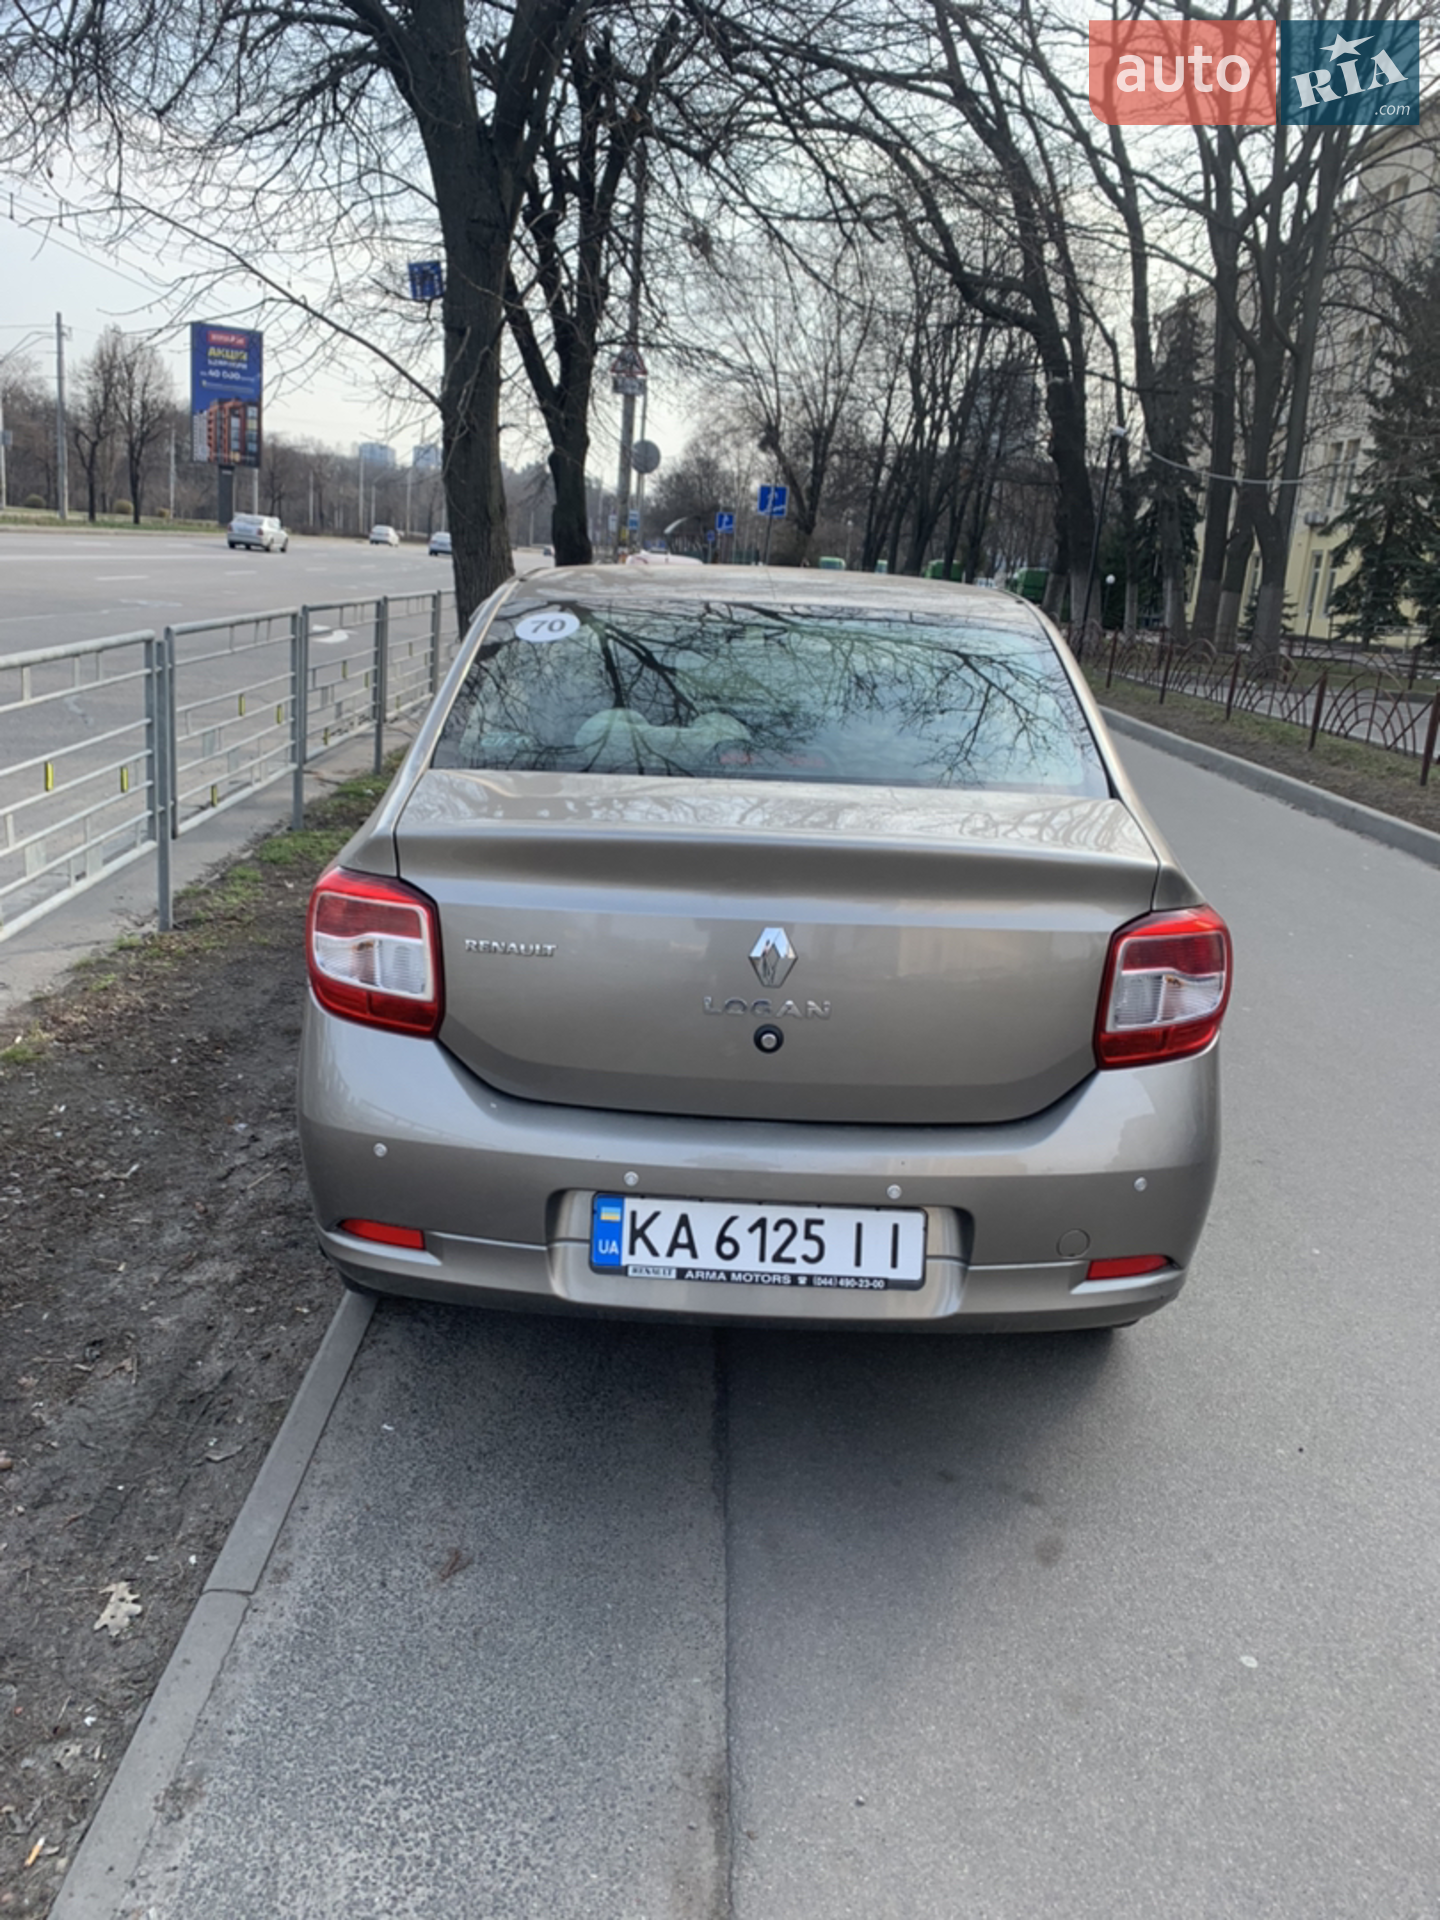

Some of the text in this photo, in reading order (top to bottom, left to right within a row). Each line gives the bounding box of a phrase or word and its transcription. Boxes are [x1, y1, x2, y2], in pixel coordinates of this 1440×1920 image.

[531, 619, 567, 634] 70
[465, 939, 557, 957] RENAULT
[703, 996, 831, 1020] LOGAN
[628, 1210, 699, 1259] KA
[715, 1215, 826, 1264] 6125
[599, 1239, 620, 1255] UA
[684, 1270, 727, 1281] ARMA
[730, 1272, 791, 1285] MOTORS
